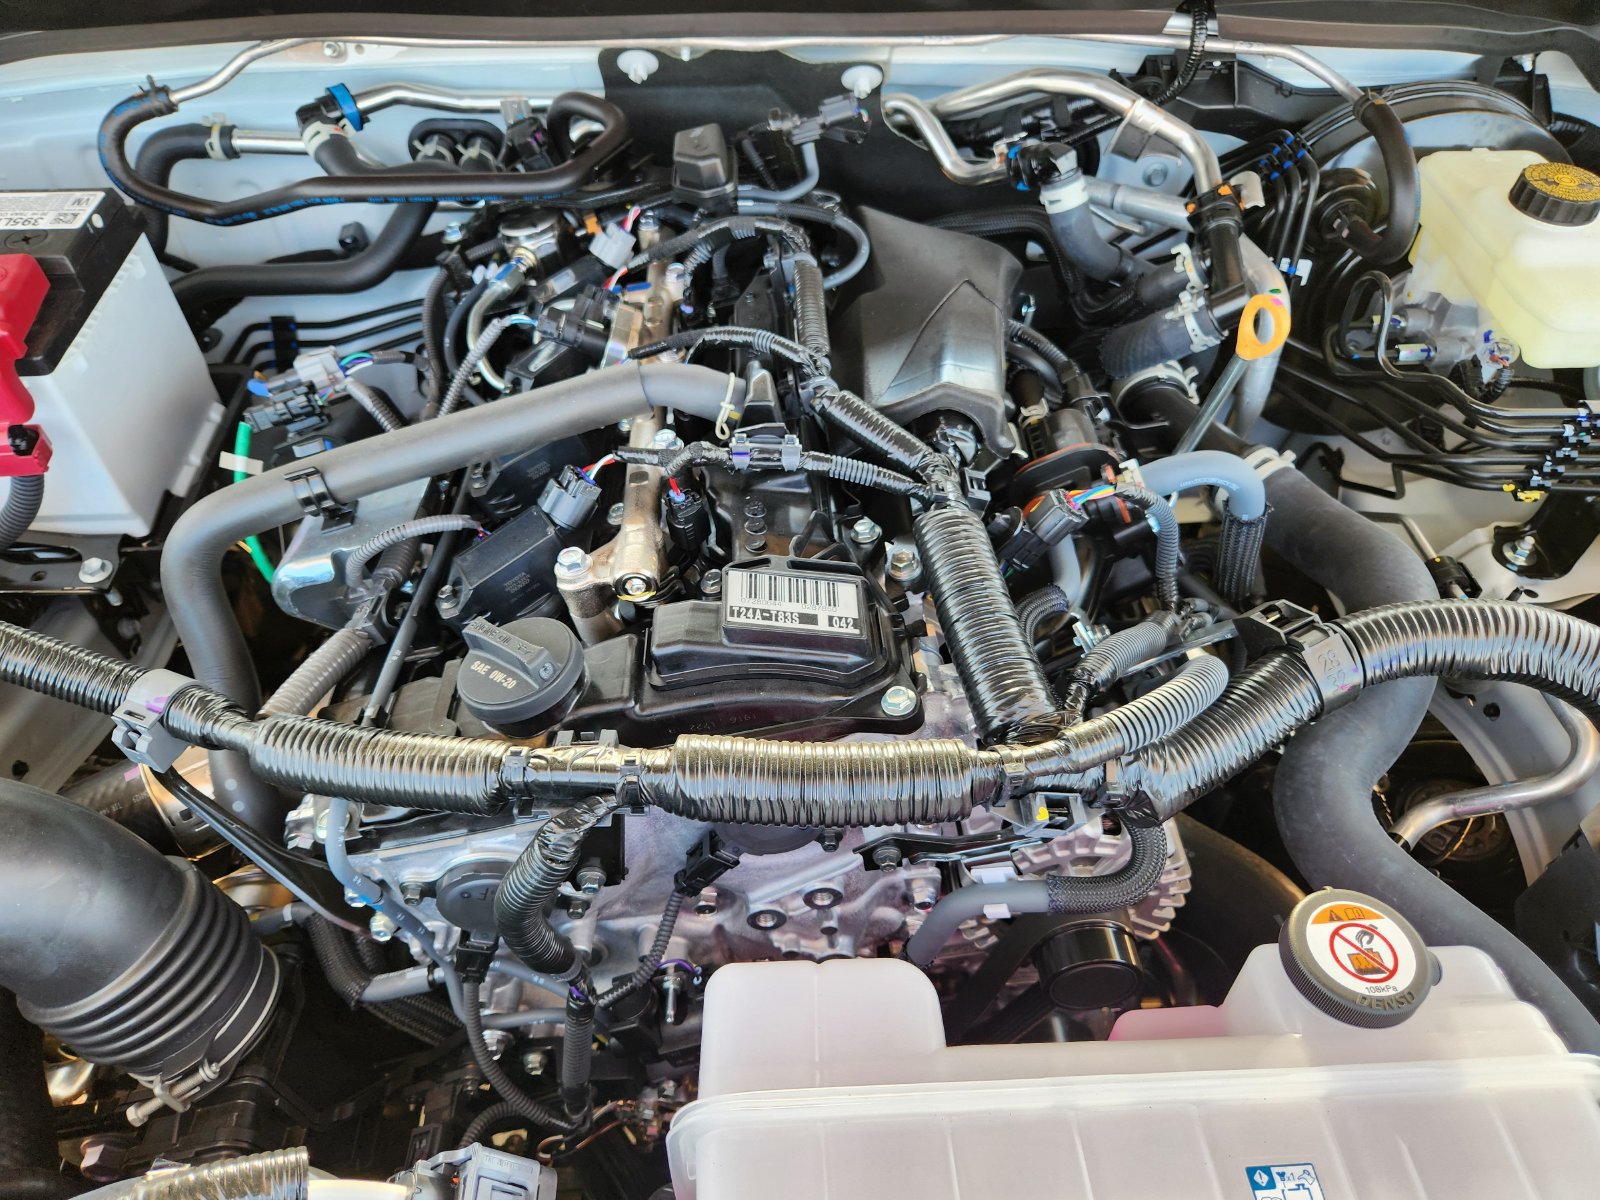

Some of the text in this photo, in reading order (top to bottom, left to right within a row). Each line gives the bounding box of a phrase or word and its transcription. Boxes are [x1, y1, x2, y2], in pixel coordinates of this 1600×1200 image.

[0, 217, 44, 227] 395L
[732, 605, 855, 629] T24A-T83S 042
[470, 661, 518, 690] SAE 0W-20
[1365, 984, 1399, 995] 108kPa
[1355, 990, 1416, 1011] DENSO
